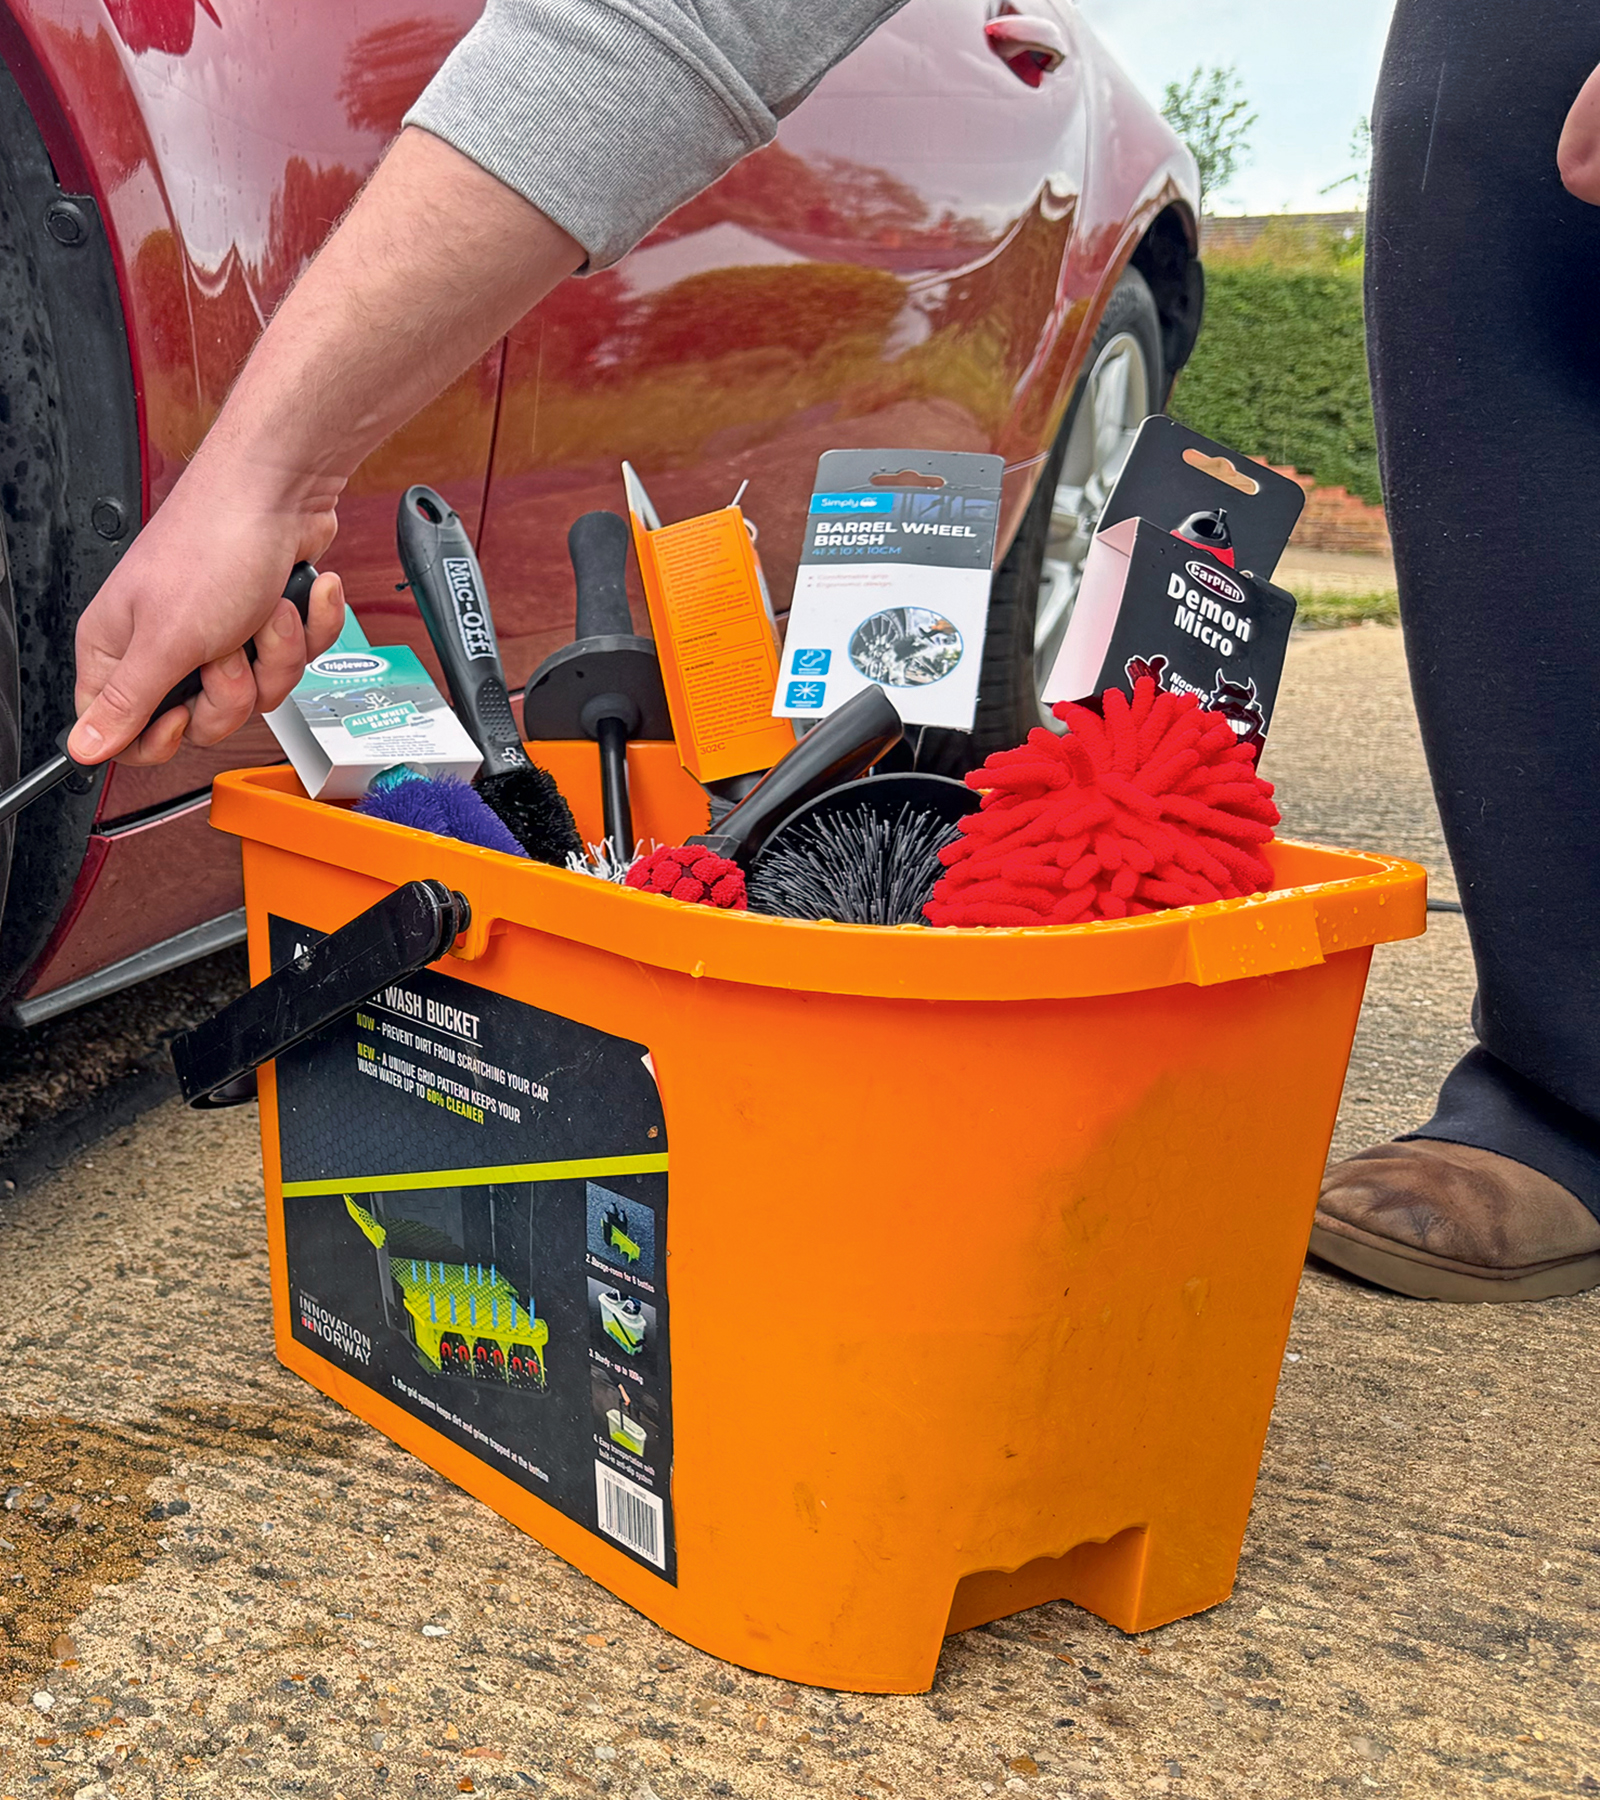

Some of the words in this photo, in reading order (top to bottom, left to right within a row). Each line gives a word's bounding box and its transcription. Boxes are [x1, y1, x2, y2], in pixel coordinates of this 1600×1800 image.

[820, 497, 861, 509] Simply
[814, 534, 885, 547] BRUSH
[816, 521, 899, 534] BARREL
[901, 522, 977, 538] WHEEL
[1189, 564, 1241, 599] CarPlan
[449, 560, 491, 656] Muc-Off
[1167, 572, 1251, 642] Demon
[1174, 604, 1233, 657] Micro
[323, 658, 377, 671] Triplewax
[1169, 671, 1210, 700] Noodle
[352, 714, 379, 728] ALLOY
[379, 706, 410, 721] WHEEL
[370, 716, 402, 731] BRUSH
[699, 741, 726, 754] 302C
[384, 982, 422, 1019] WASH
[426, 998, 480, 1041] BUCKET
[356, 1011, 375, 1032] NOW
[381, 1021, 413, 1048] PREVENT
[414, 1034, 432, 1055] DIRT
[433, 1041, 455, 1065] FROM
[456, 1051, 505, 1086] SCRATCHING
[506, 1071, 530, 1096] YOUR
[531, 1081, 549, 1103] CAR
[356, 1041, 375, 1061] NEW
[381, 1051, 387, 1067] A
[388, 1054, 416, 1080] UNIQUE
[416, 1066, 435, 1087] GRID
[436, 1074, 469, 1102] PATTERN
[470, 1089, 496, 1114] KEEPS
[497, 1100, 521, 1124] YOUR
[357, 1056, 378, 1079] WASH
[378, 1066, 402, 1090] WATER
[403, 1076, 414, 1095] UP
[415, 1081, 425, 1100] TO
[426, 1086, 444, 1108] 60%
[445, 1095, 484, 1125] CLEANER
[300, 1295, 371, 1349] INNOVATION
[313, 1318, 371, 1366] NORWAY
